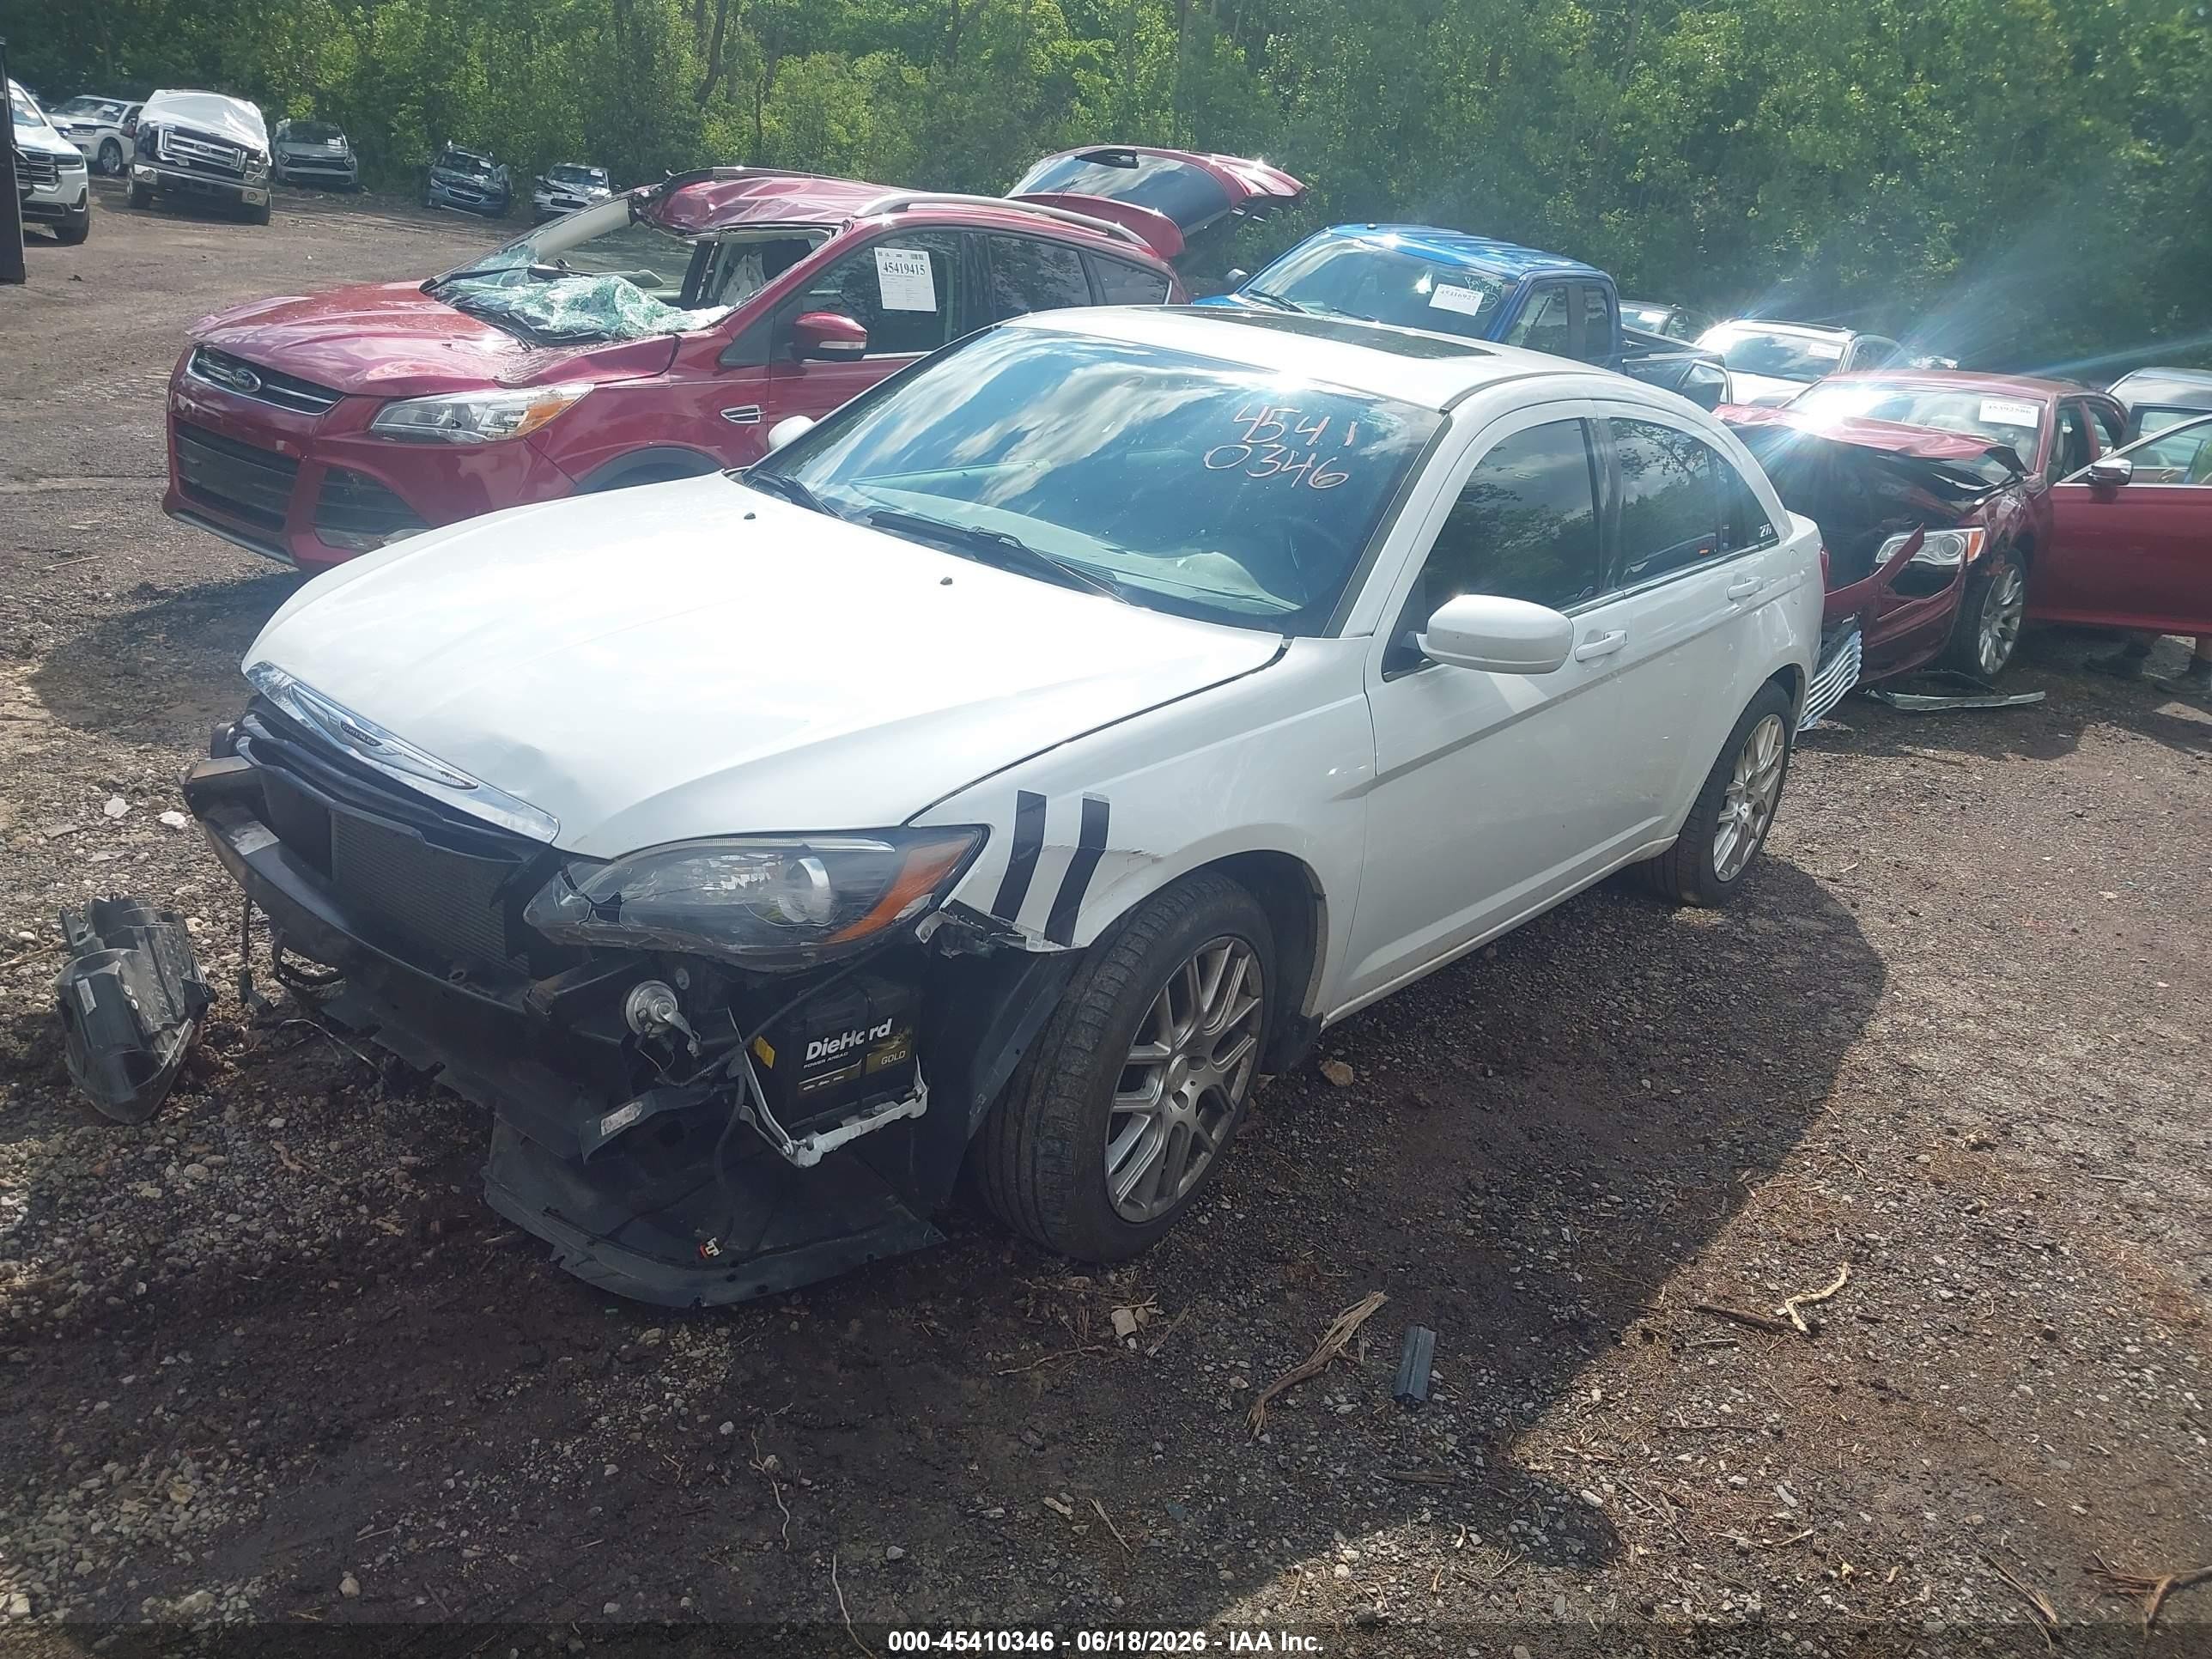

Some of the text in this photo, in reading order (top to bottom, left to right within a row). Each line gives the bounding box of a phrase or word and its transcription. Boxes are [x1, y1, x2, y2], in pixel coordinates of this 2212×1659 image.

[884, 261, 926, 276] 45419415
[1233, 404, 1358, 447] 4541
[1204, 443, 1350, 489] 0346
[804, 1058, 826, 1070] POWER
[880, 1050, 907, 1066] GOLD
